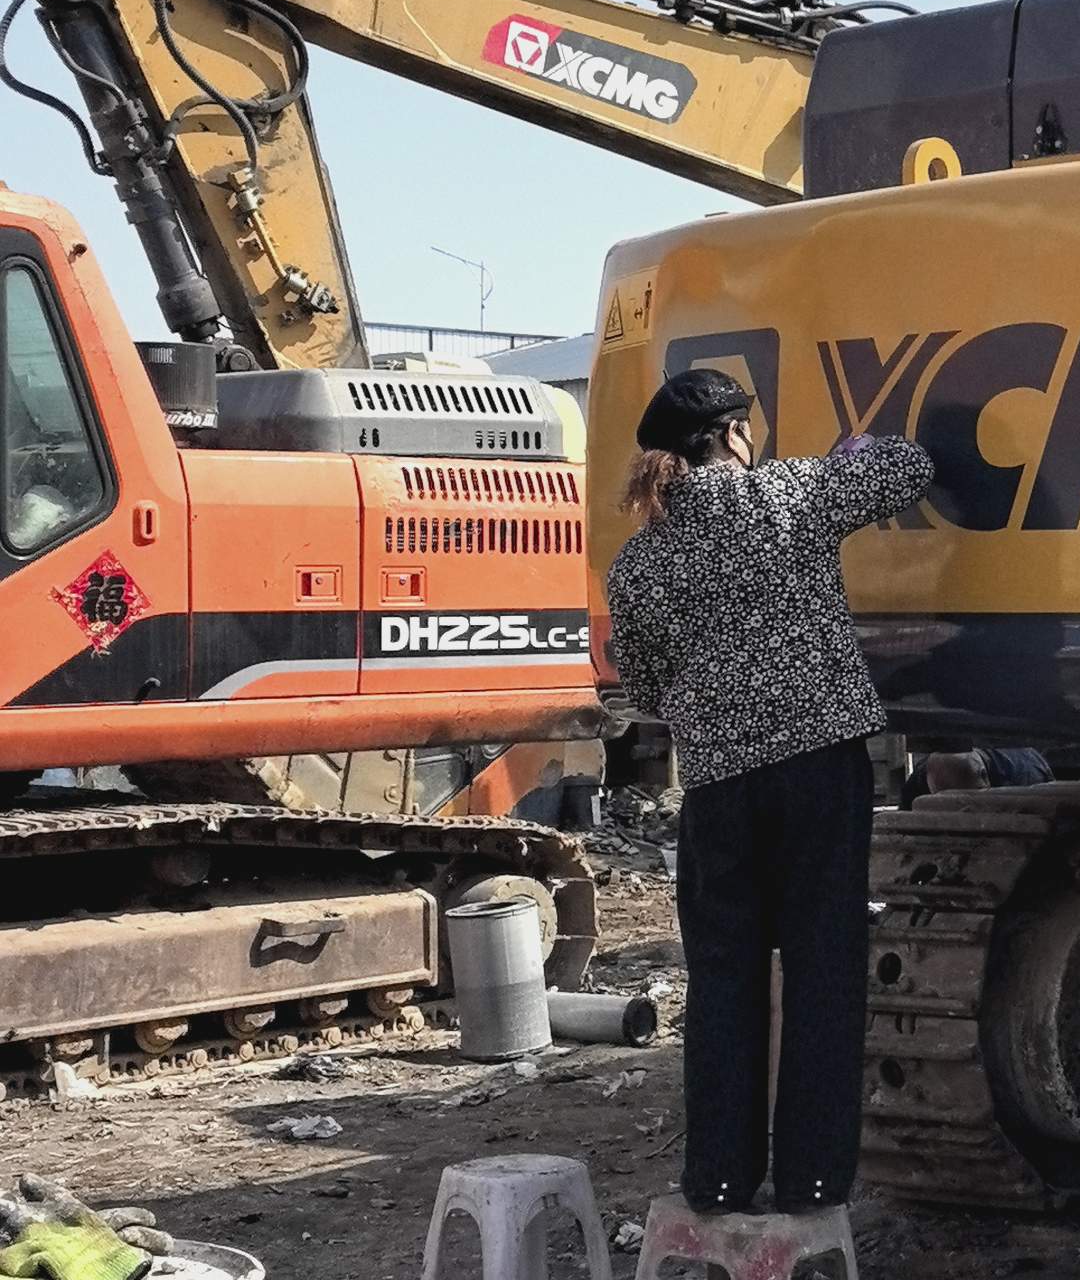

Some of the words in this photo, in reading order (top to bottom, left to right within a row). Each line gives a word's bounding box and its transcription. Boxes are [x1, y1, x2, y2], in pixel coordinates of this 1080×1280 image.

[542, 42, 679, 119] XCMG
[166, 412, 202, 426] urbo
[80, 571, 129, 625] 福
